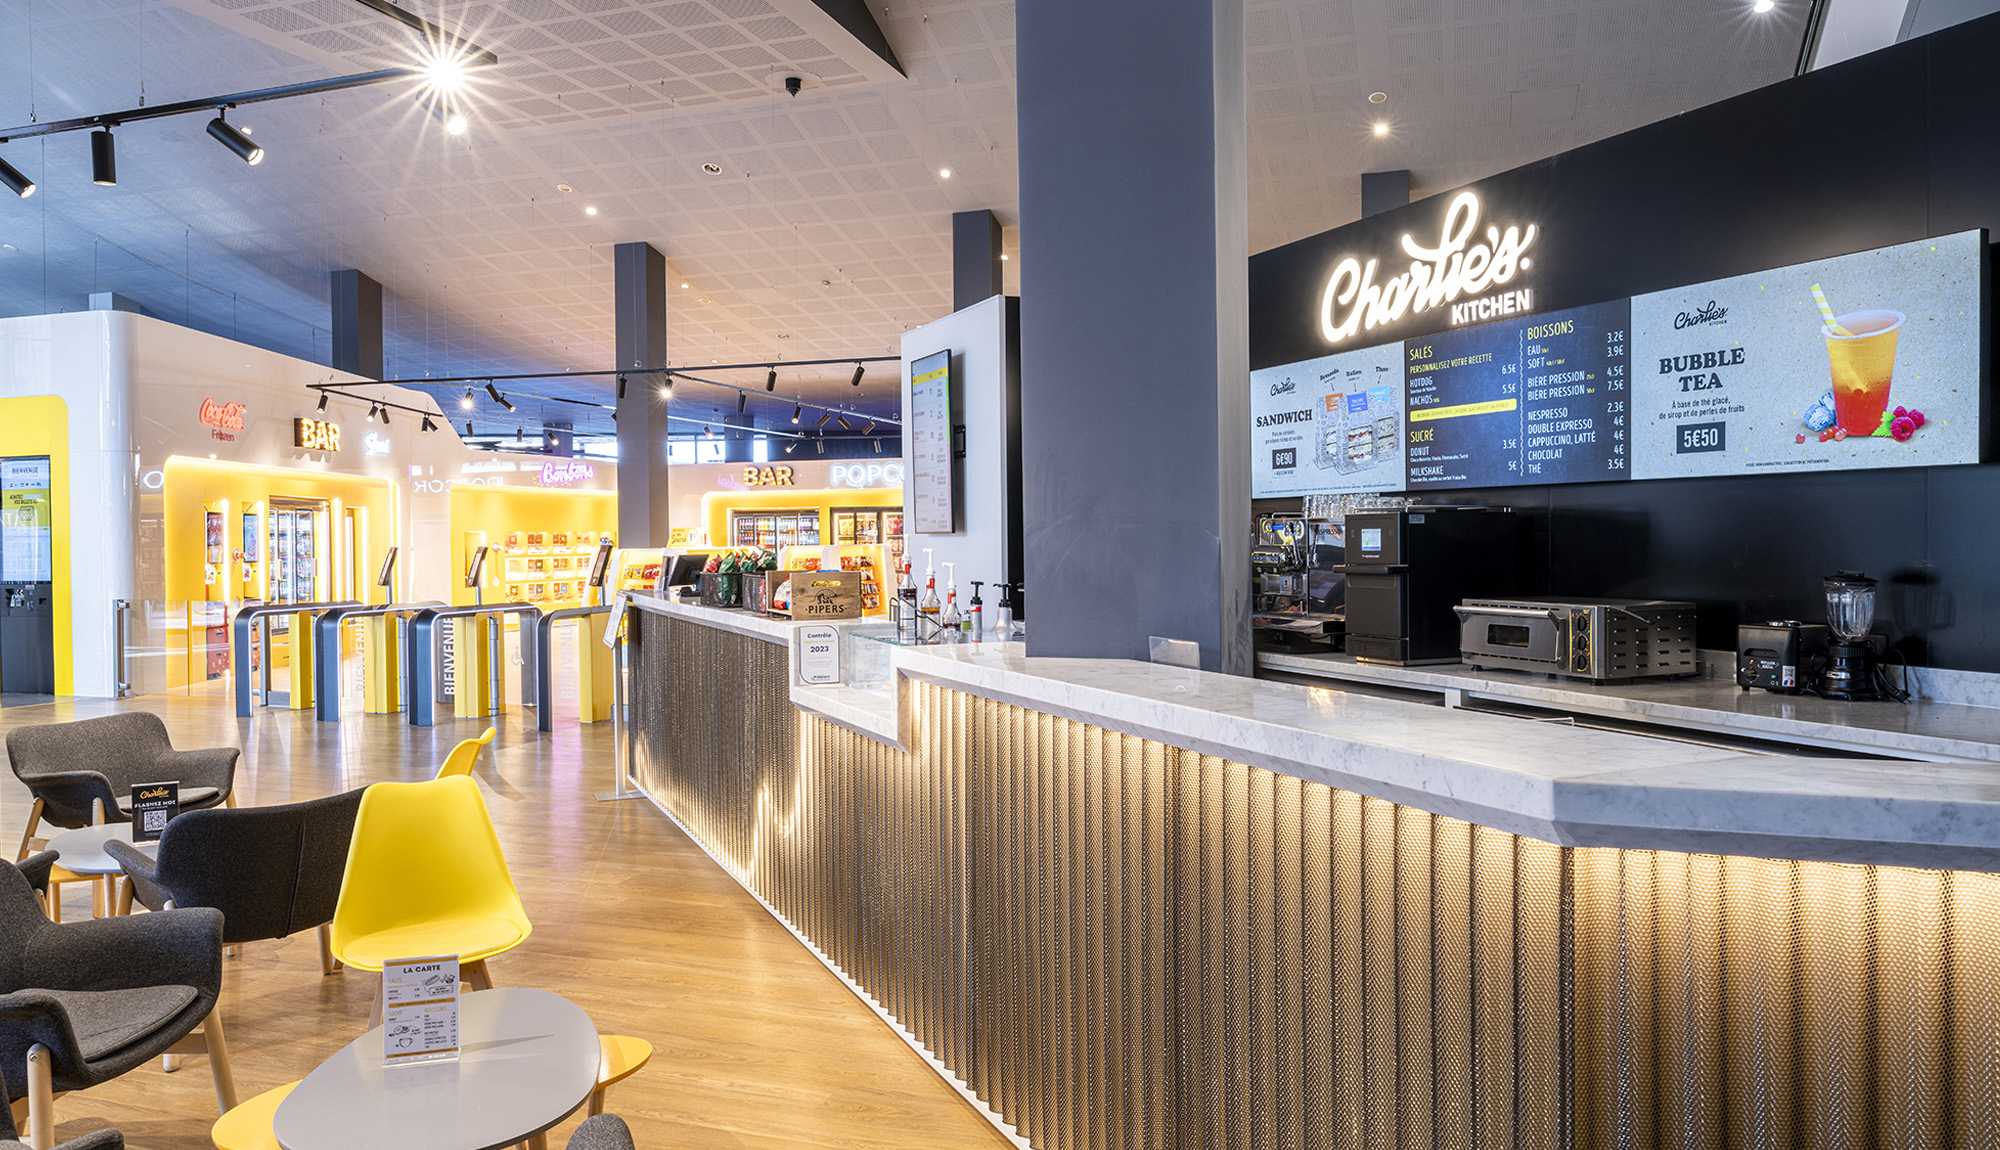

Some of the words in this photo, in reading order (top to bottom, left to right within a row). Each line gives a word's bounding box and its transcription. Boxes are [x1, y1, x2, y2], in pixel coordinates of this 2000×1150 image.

[1452, 289, 1531, 325] KITCHEN
[1527, 319, 1574, 340] BOISSONS
[1607, 330, 1624, 343] 3.2€
[1527, 345, 1540, 356] EAU
[1607, 345, 1624, 357] 3.9€
[1409, 359, 1451, 374] PERSONNALISEZ
[1451, 356, 1468, 367] VOTRE
[1468, 353, 1492, 366] RECETTE
[1527, 357, 1545, 369] SOFT
[1659, 347, 1745, 374] BUBBLE
[1502, 363, 1516, 375] 6.5€
[1606, 365, 1624, 377] 4.5€
[1410, 376, 1433, 388] HOTDOG
[1549, 371, 1585, 384] PRESSION
[1678, 373, 1723, 392] TEA
[1502, 383, 1516, 394] 5.5€
[1607, 379, 1624, 391] 7.5€
[1549, 385, 1585, 398] PRESSION
[1410, 395, 1432, 406] NACHOS
[1677, 401, 1691, 409] base
[1607, 401, 1624, 413] 2.3€
[1659, 412, 1666, 420] de
[1667, 411, 1682, 420] sirop
[1683, 410, 1690, 418] et
[1690, 409, 1698, 417] de
[1699, 408, 1718, 417] perles
[1718, 407, 1727, 415] de
[1728, 405, 1745, 413] fruits
[1256, 409, 1313, 428] SANDWICH
[1527, 407, 1568, 421] NESPRESSO
[1528, 422, 1554, 434] DOUBLE
[1555, 418, 1593, 432] EXPRESSO
[1613, 415, 1624, 426] 4€
[302, 417, 341, 452] BAR
[1613, 430, 1624, 441] 4€
[1684, 428, 1718, 448] 5€50
[1503, 439, 1517, 449] 3.5€
[1613, 444, 1624, 455] 4€
[1410, 446, 1430, 457] DONUT
[1528, 448, 1563, 461] CHOCOLAT
[1275, 452, 1293, 466] 6€90
[1607, 458, 1624, 470] 3.5€
[1410, 465, 1444, 477] MILKSHAKE
[1508, 460, 1517, 471] 5€
[743, 465, 794, 487] BAR
[808, 604, 845, 614] PIPERS
[810, 645, 829, 653] 2023
[415, 965, 441, 973] CARTE
